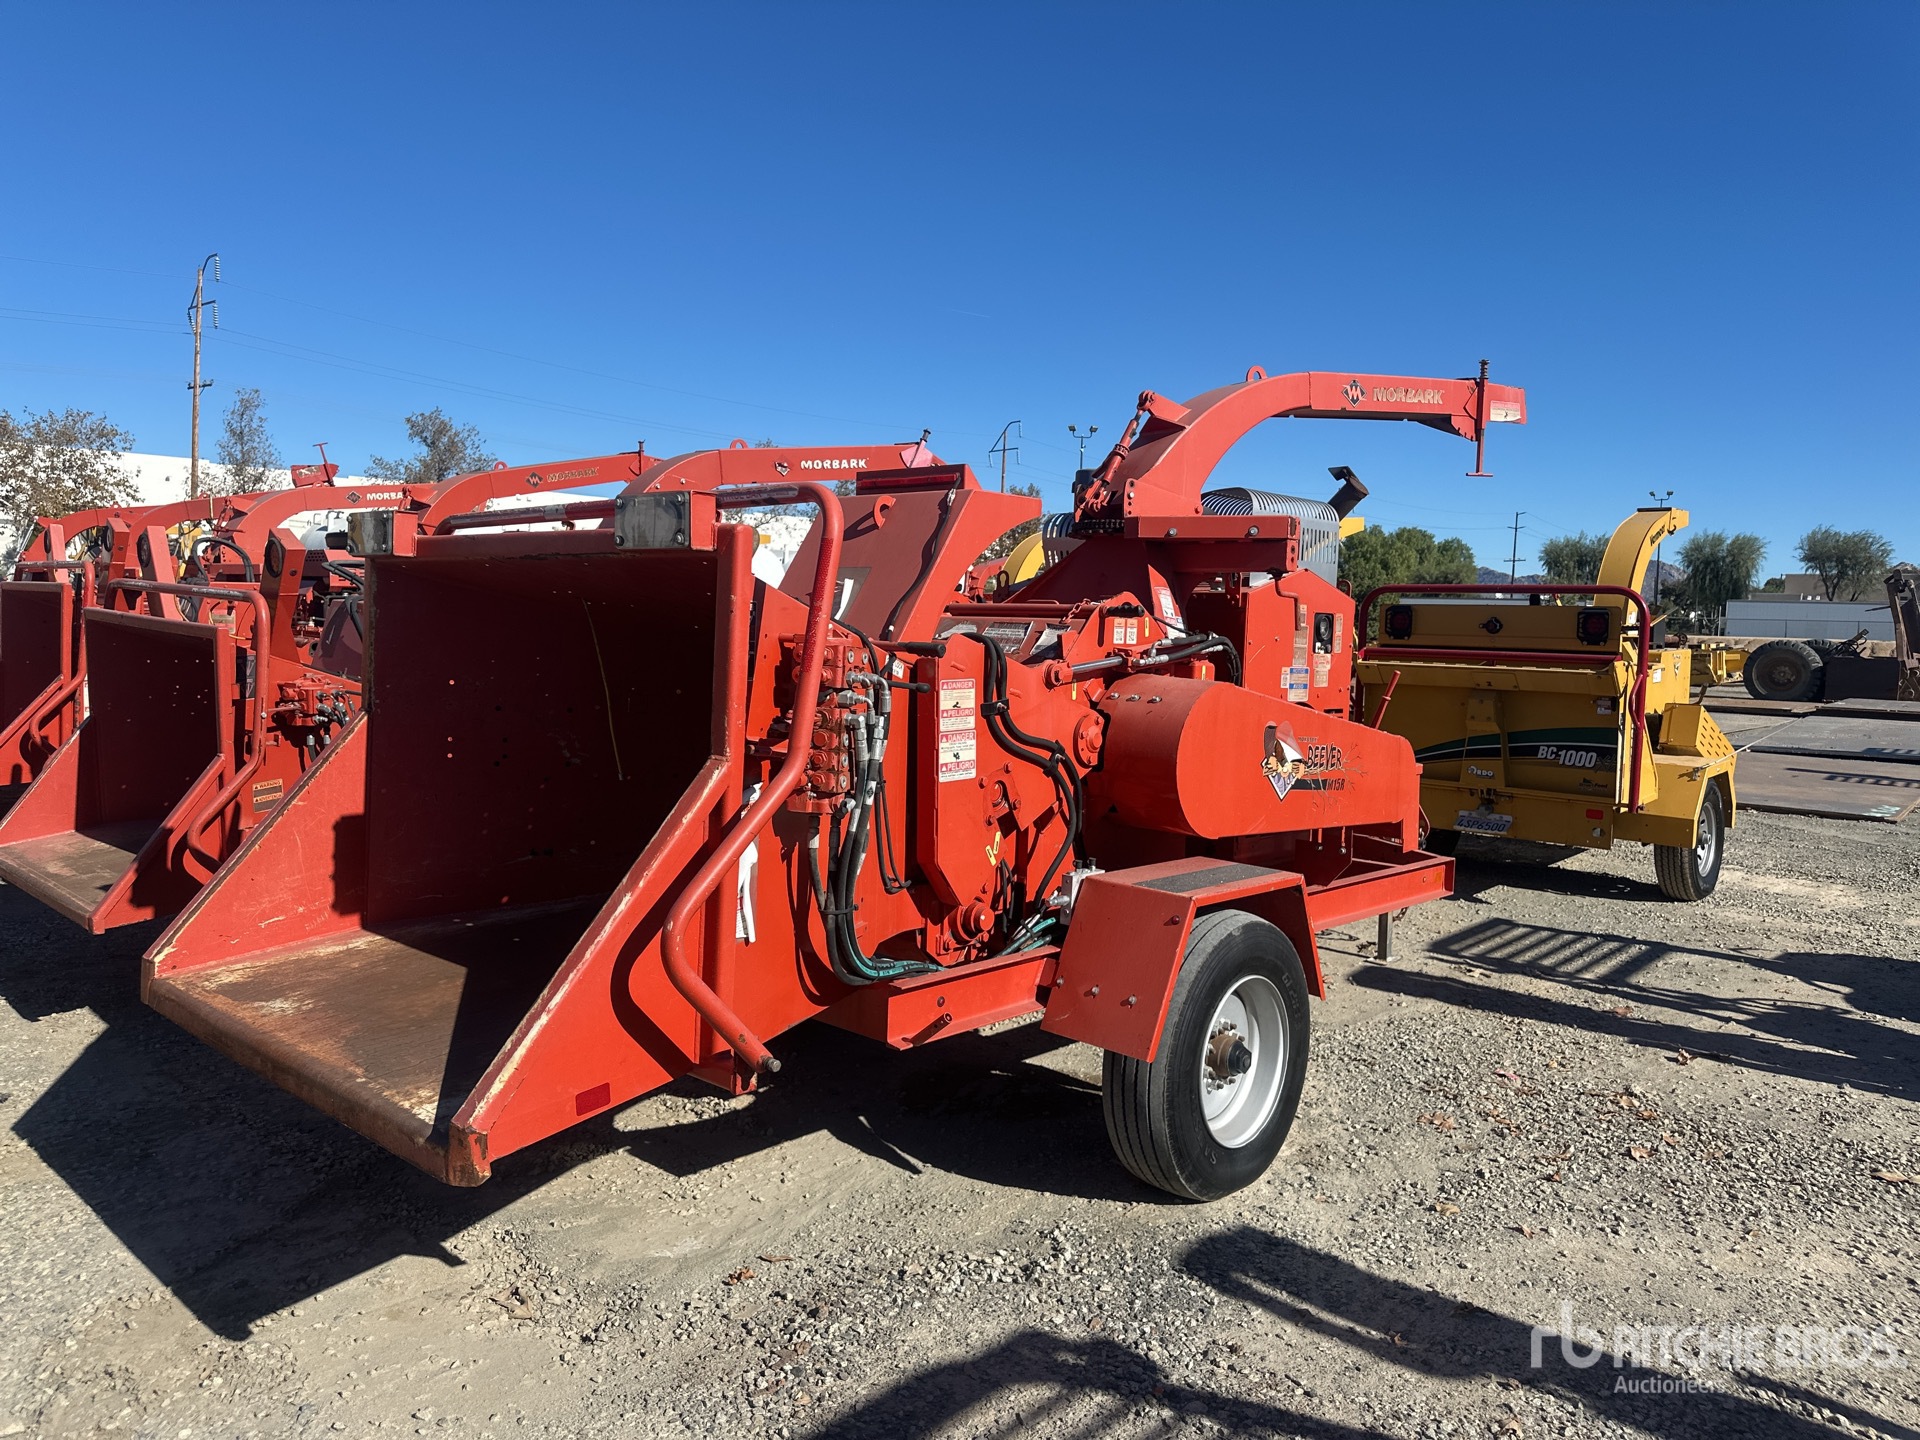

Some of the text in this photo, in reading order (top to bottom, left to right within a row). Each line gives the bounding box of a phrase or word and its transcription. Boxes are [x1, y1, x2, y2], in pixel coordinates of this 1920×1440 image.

[1373, 387, 1443, 404] MORBARK
[800, 459, 868, 470] MORBARK
[366, 492, 404, 501] MORBA
[948, 681, 974, 690] DANGER
[948, 709, 974, 718] PELIGRO
[948, 733, 975, 743] DANGER
[1307, 743, 1342, 770] BEEVER
[947, 761, 974, 771] PELIGRO
